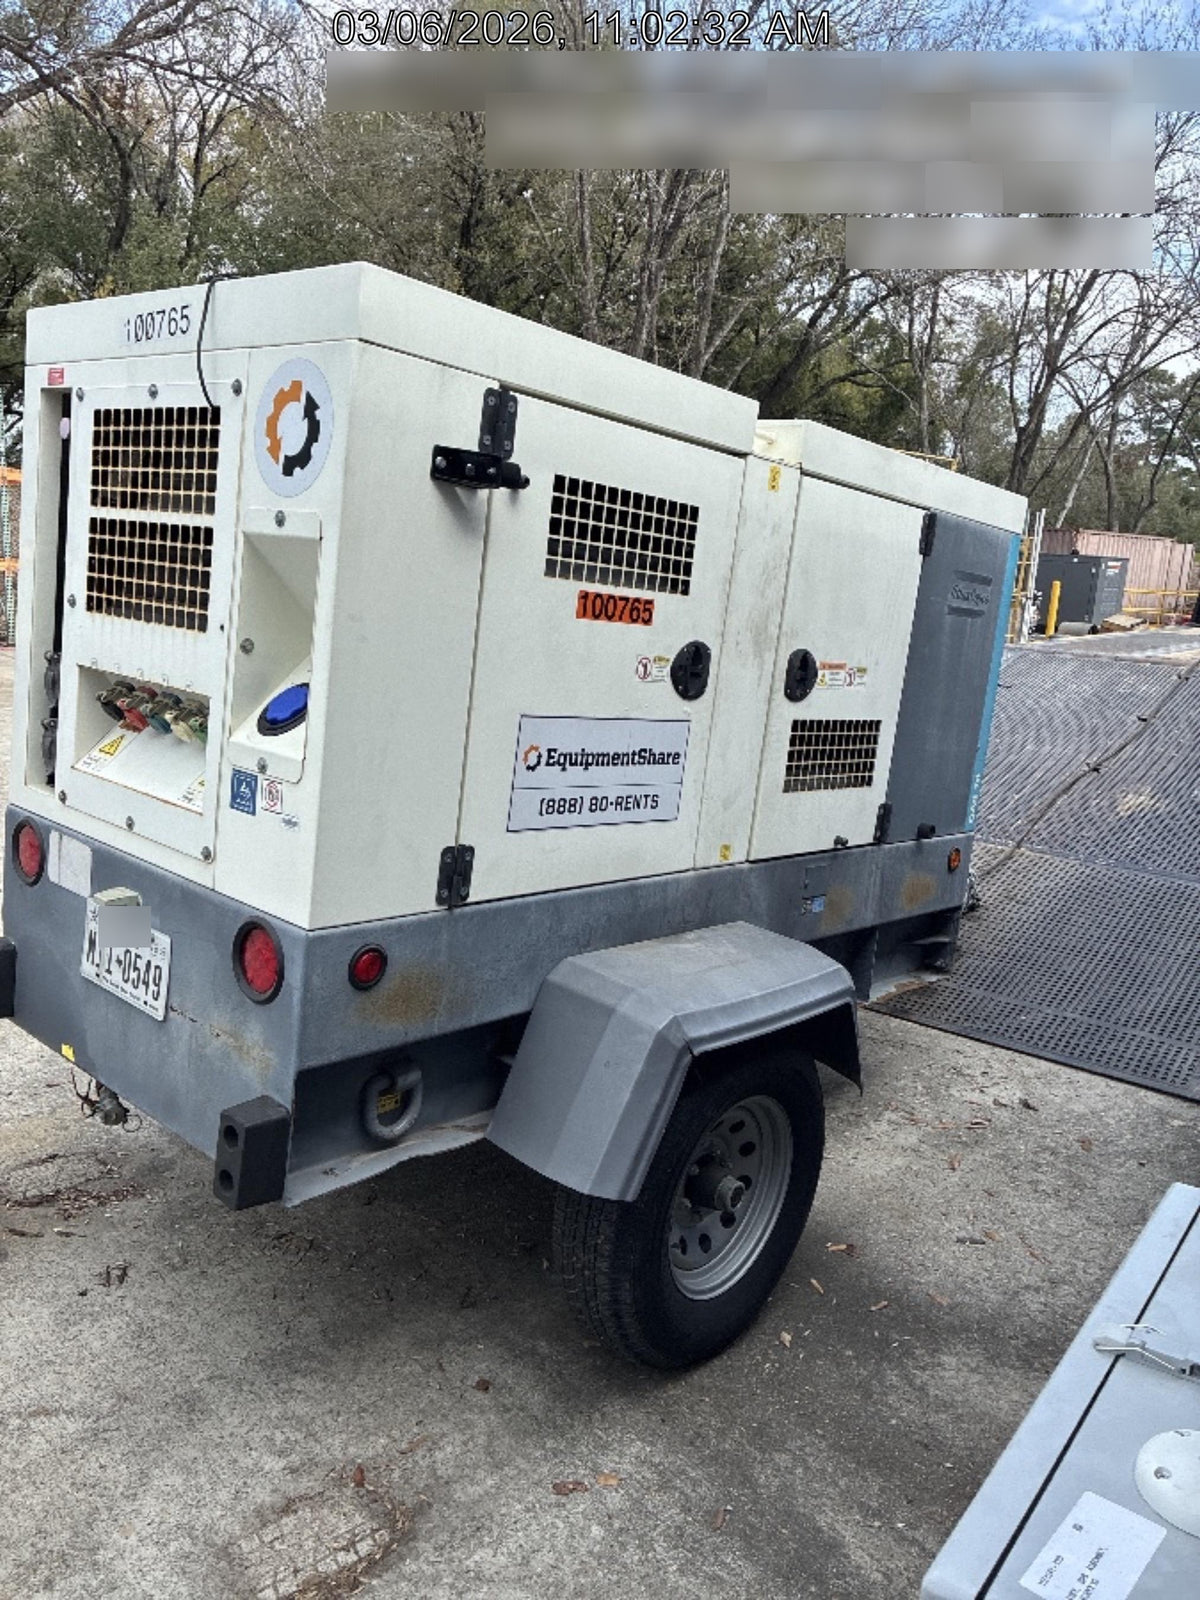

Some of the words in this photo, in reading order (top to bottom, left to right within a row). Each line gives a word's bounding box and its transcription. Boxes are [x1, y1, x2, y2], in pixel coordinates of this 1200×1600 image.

[124, 304, 192, 343] 100765
[579, 591, 654, 625] 100765
[544, 748, 682, 772] EquipmentShare
[538, 797, 584, 817] (888)
[588, 794, 660, 814] 80-RENTS
